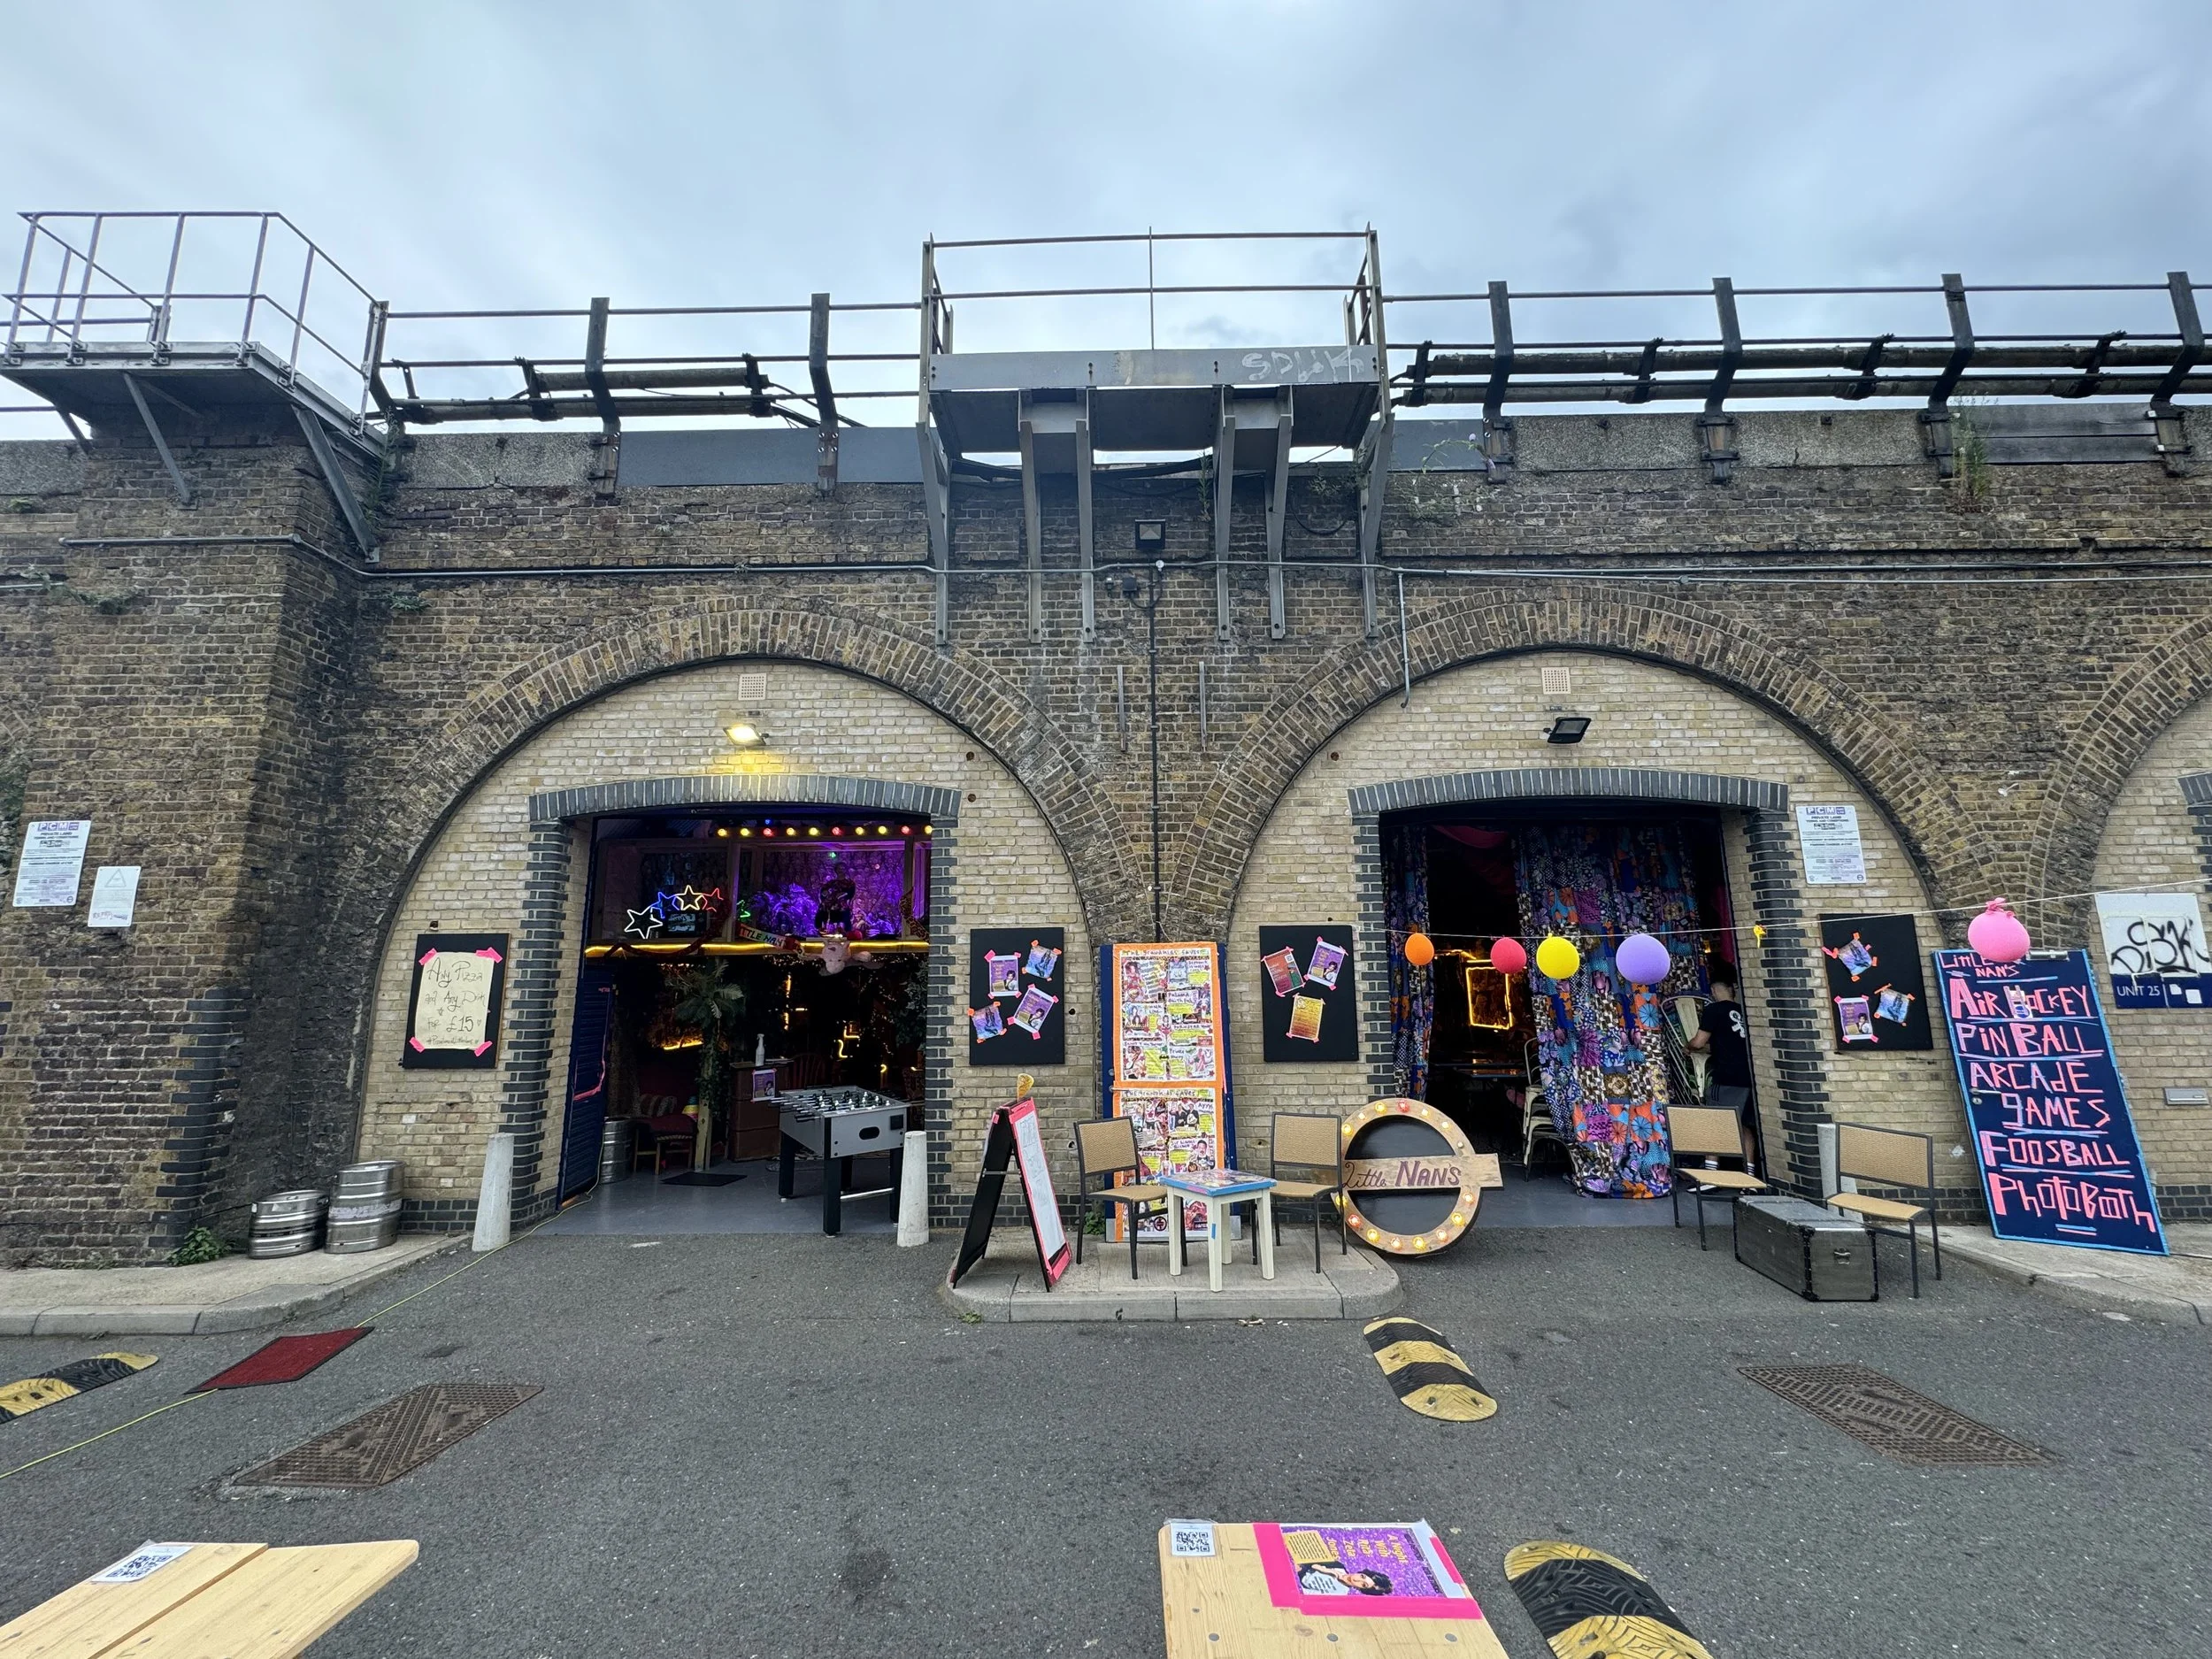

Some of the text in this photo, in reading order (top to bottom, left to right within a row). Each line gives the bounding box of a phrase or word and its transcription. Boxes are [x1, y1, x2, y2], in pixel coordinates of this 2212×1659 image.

[2116, 985, 2161, 996] UNIT 25
[446, 1016, 474, 1033] £15
[1979, 1130, 2131, 1166] FOOSBALL
[1342, 1161, 1387, 1189] Little
[1325, 1536, 1340, 1561] Jones
[1373, 1539, 1390, 1558] With
[1389, 1541, 1409, 1564] Night
